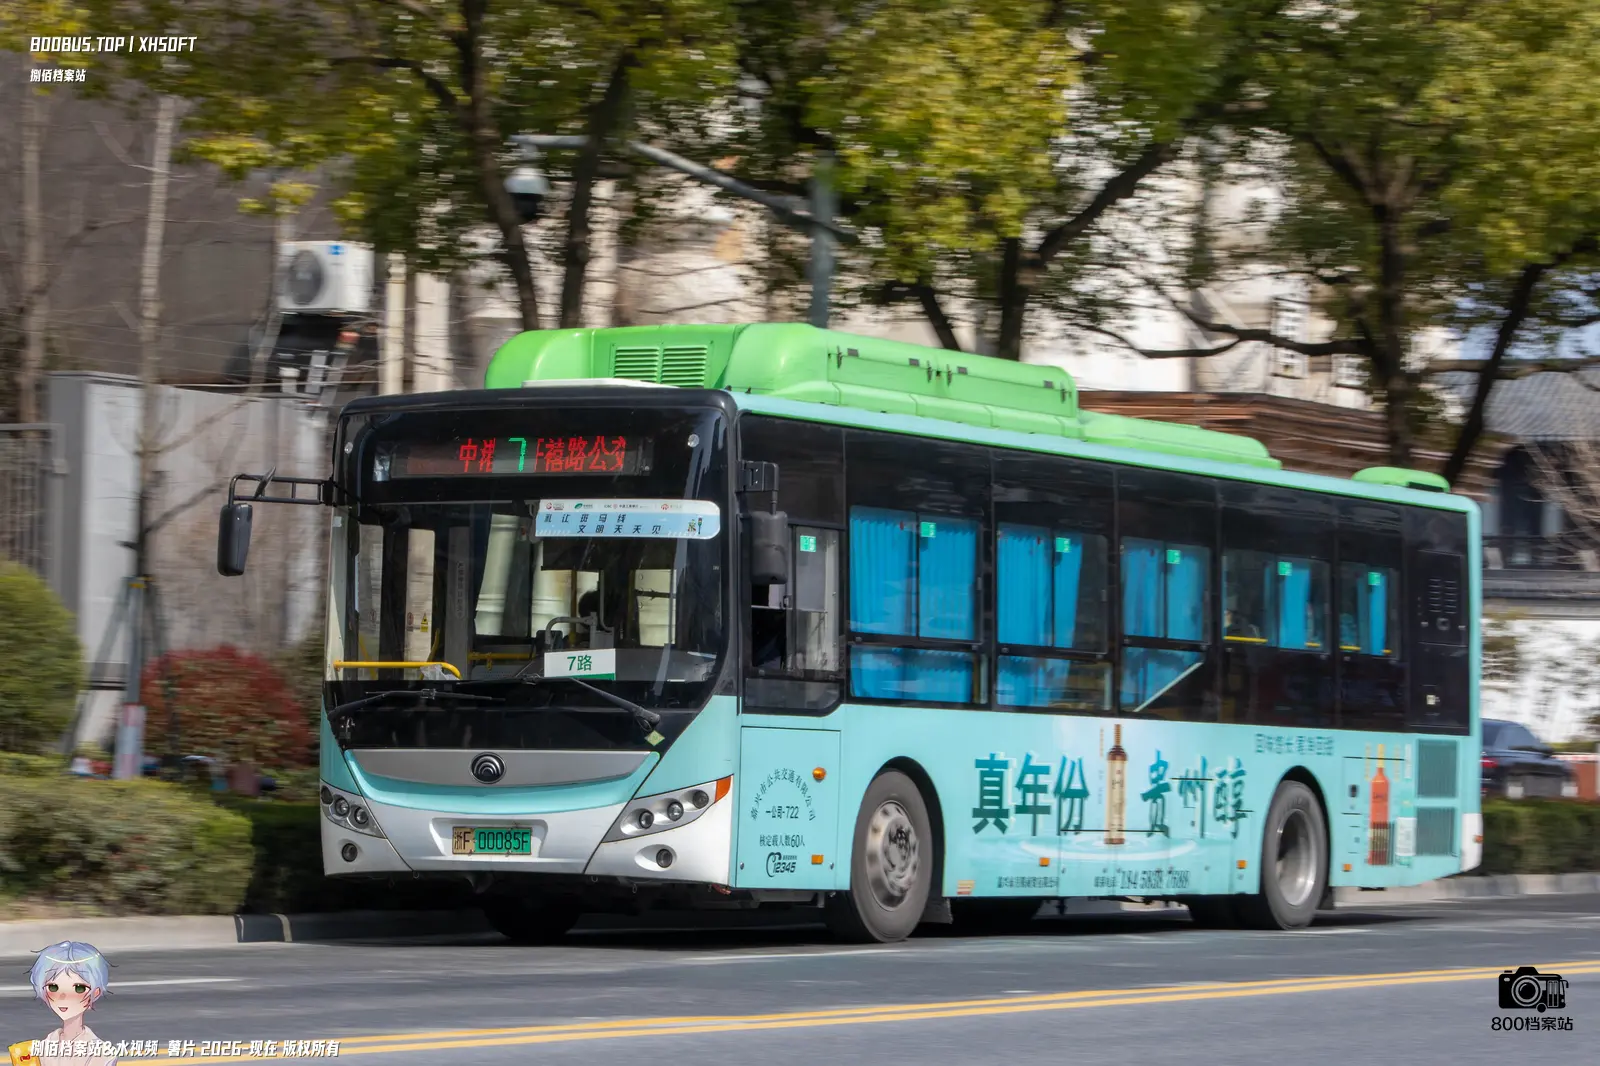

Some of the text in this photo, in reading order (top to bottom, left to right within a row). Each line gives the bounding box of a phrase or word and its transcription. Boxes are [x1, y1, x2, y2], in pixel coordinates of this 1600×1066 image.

[508, 437, 527, 472] 7
[544, 513, 626, 523] 礼让斑马线
[577, 524, 661, 535] 文明天天见
[567, 654, 592, 672] 7路
[972, 749, 1090, 837] 真年份
[1140, 749, 1247, 839] 贵州醇
[478, 831, 530, 850] 00085F
[772, 862, 797, 874] 12345
